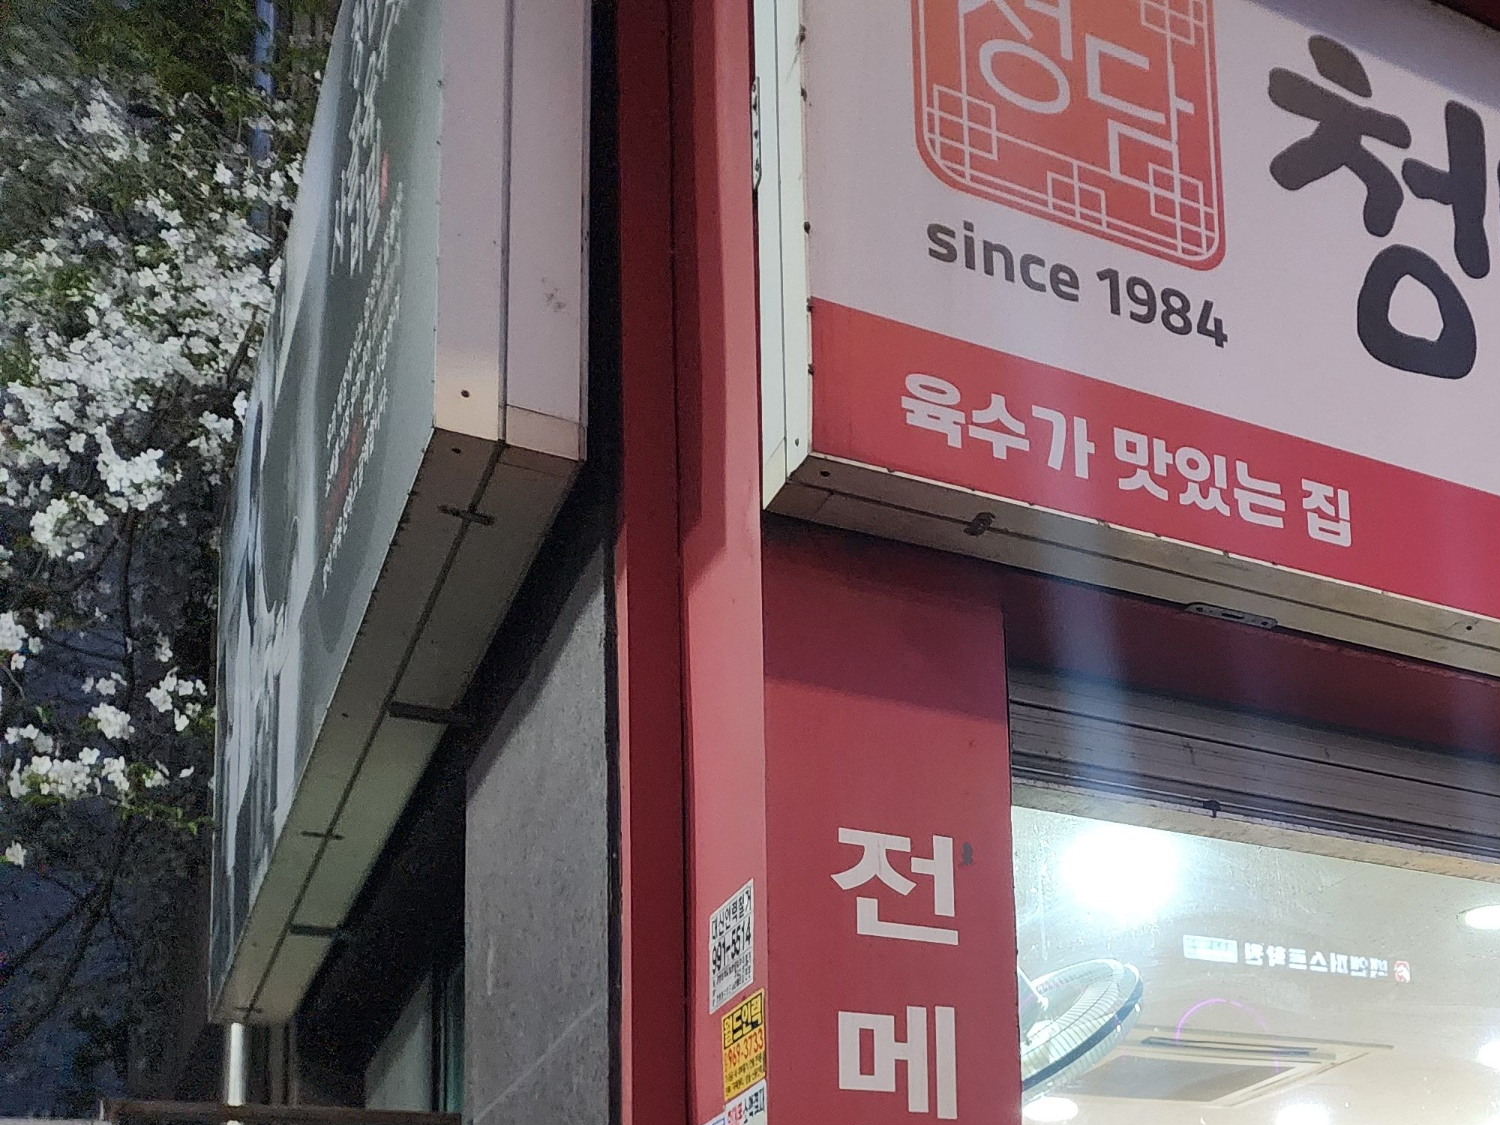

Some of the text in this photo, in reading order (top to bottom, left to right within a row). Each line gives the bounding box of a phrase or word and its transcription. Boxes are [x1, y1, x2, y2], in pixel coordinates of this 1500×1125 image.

[926, 220, 1229, 349] since 1984
[900, 372, 1353, 548] 육수가 맛있는 집
[831, 827, 959, 946] 전
